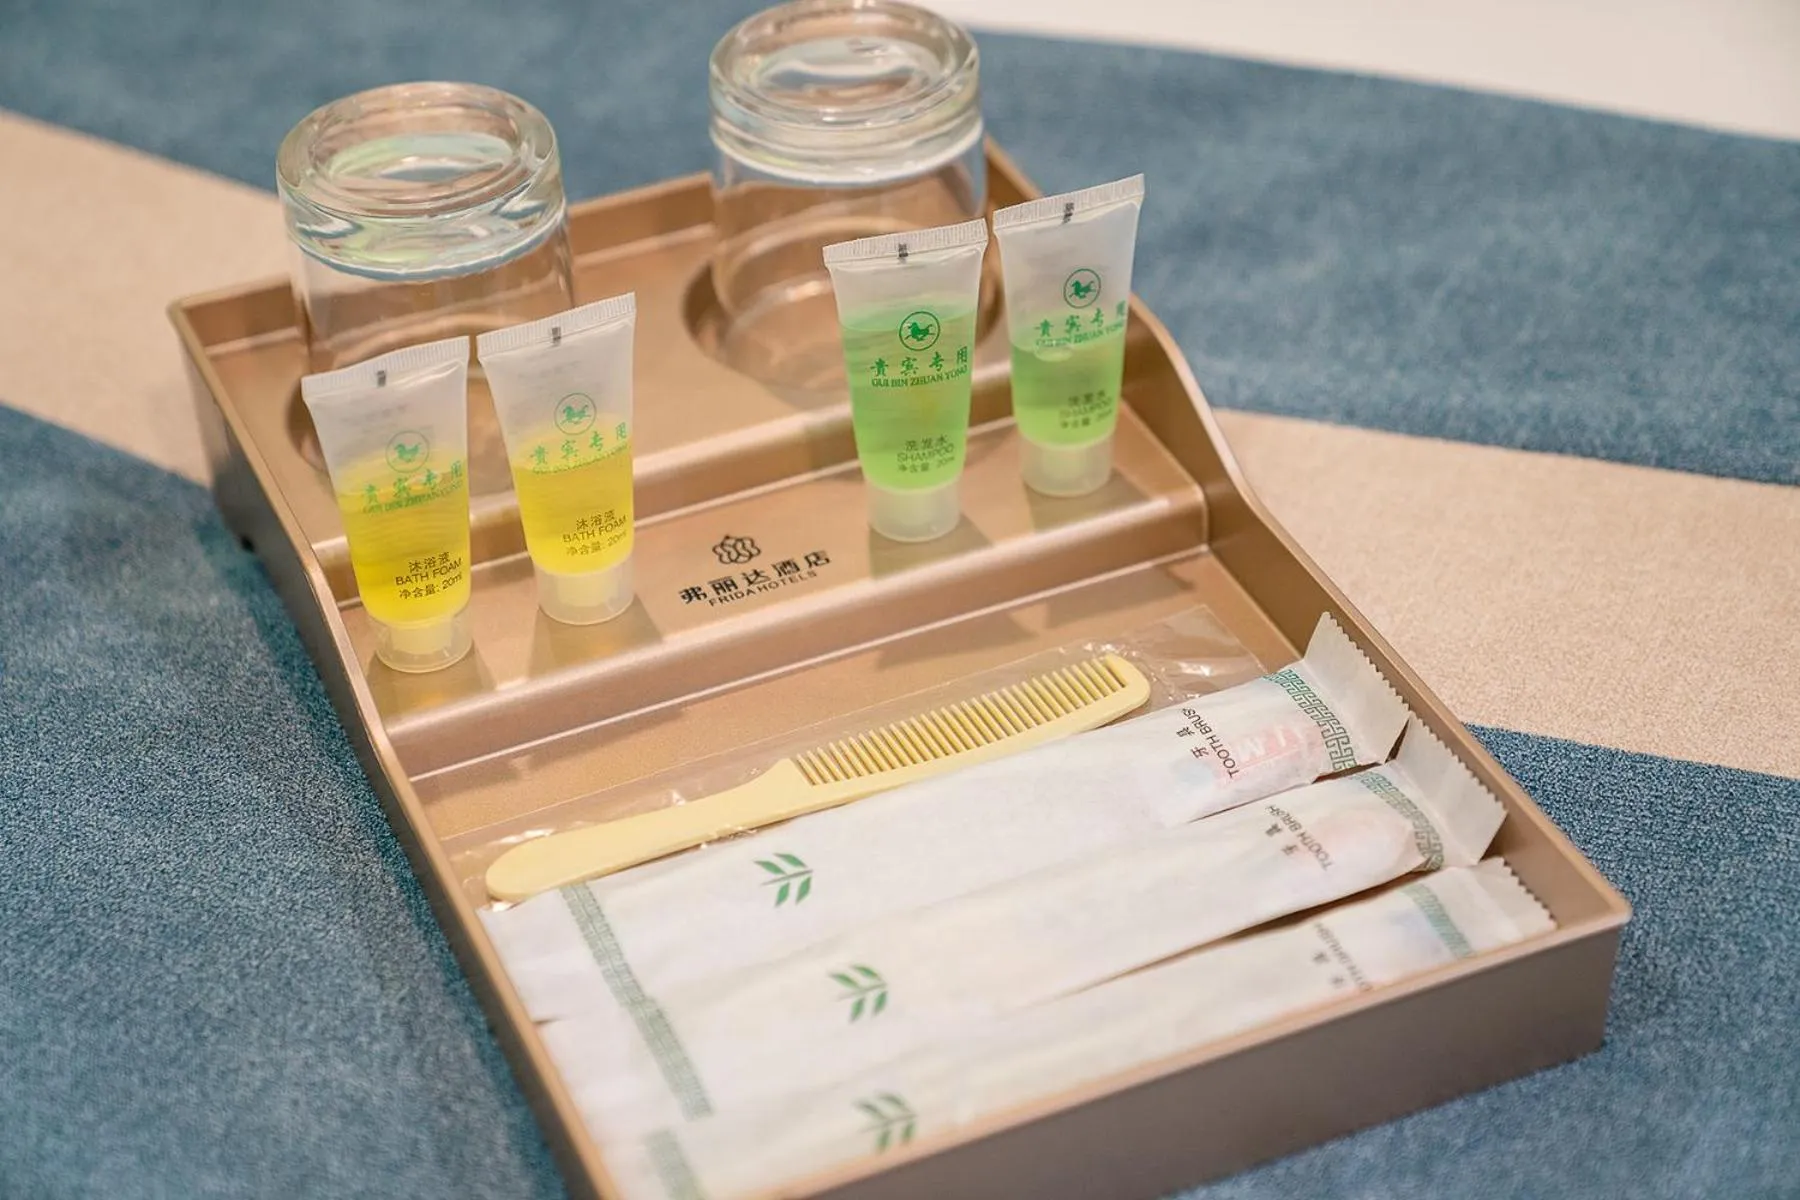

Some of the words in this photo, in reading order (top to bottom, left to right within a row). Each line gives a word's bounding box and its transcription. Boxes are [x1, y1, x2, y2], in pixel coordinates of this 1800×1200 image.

[563, 529, 595, 543] BATH
[598, 514, 626, 536] FOAM
[395, 571, 429, 586] BATH
[432, 556, 462, 578] FOAM
[678, 549, 831, 605] 弗丽达酒店
[1206, 734, 1240, 778] TOOTH
